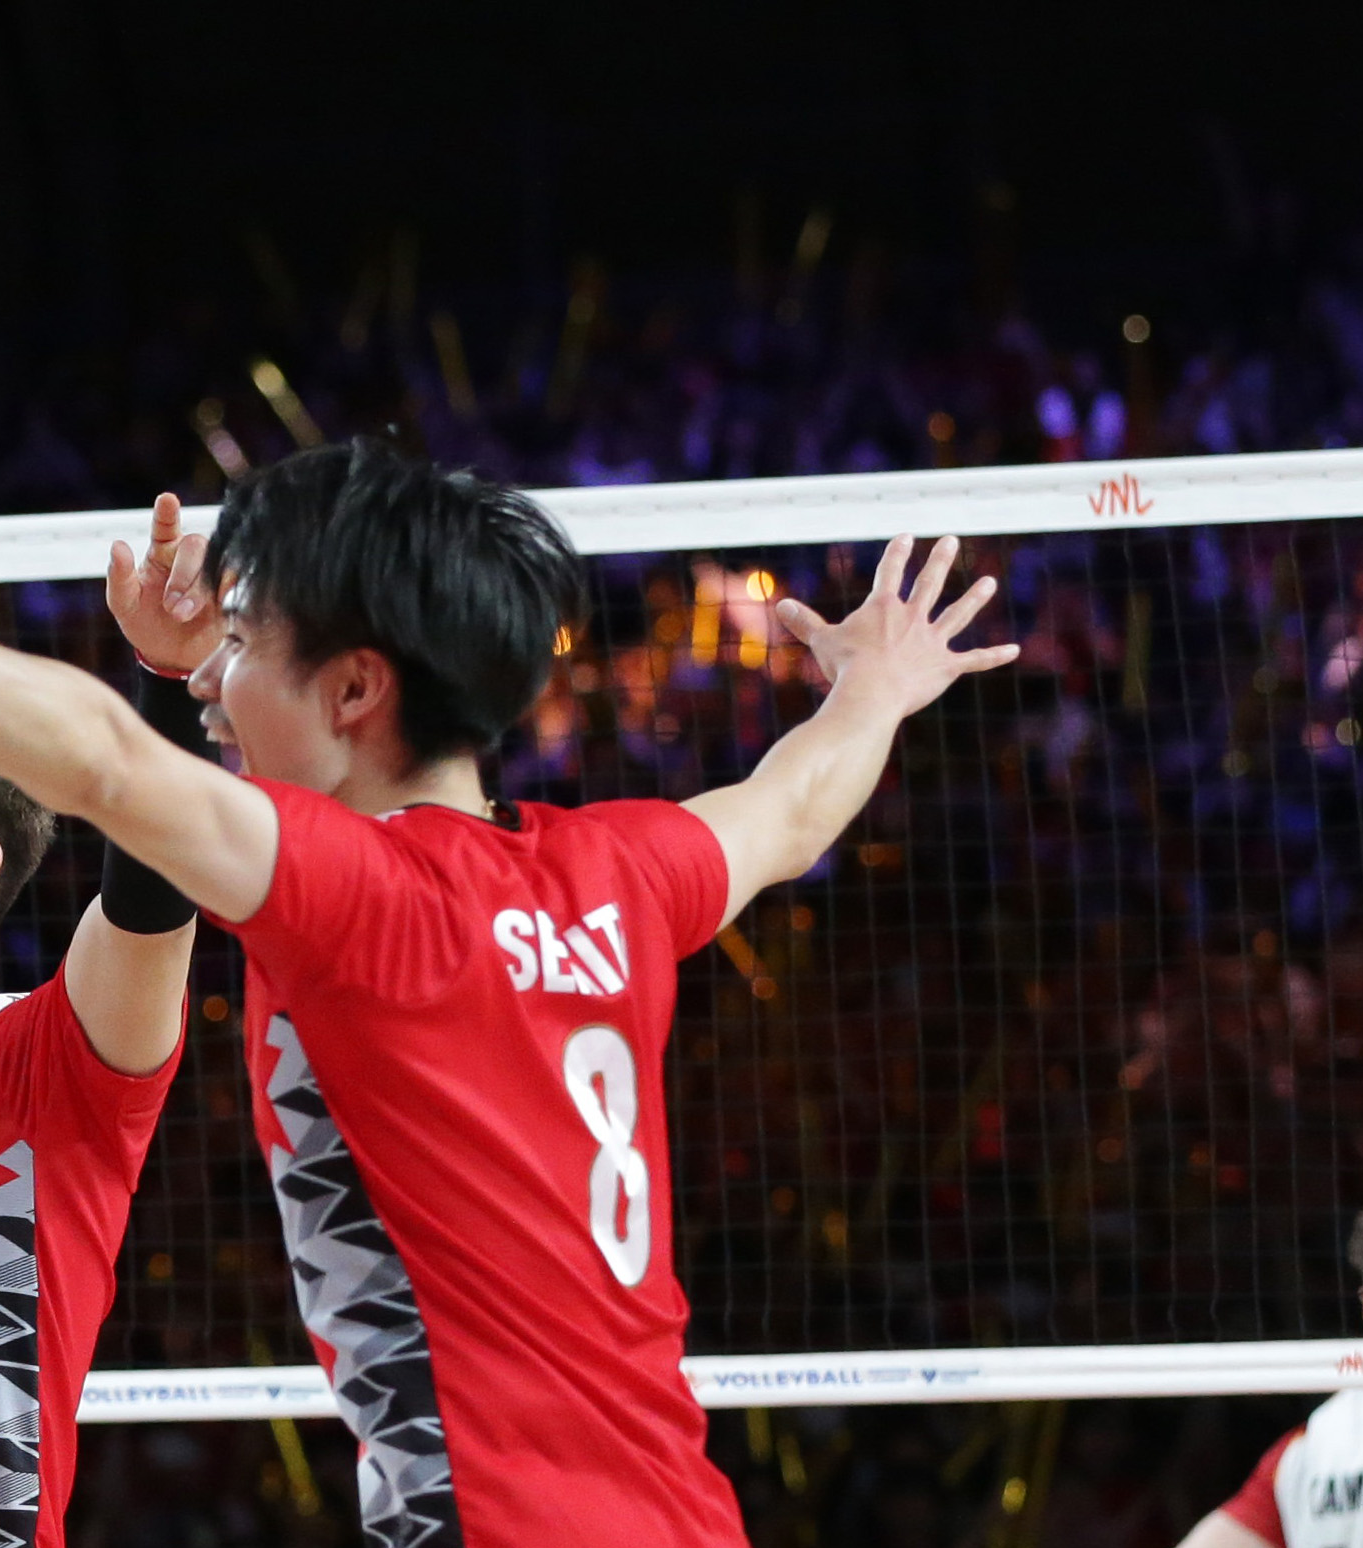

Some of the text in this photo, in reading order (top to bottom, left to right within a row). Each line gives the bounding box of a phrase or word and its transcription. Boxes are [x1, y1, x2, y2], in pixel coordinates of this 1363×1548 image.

[1088, 472, 1154, 516] VNL
[563, 1022, 651, 1289] 8
[81, 1384, 213, 1404] OLLEYBALL
[713, 1368, 865, 1389] VOLLEYBALL
